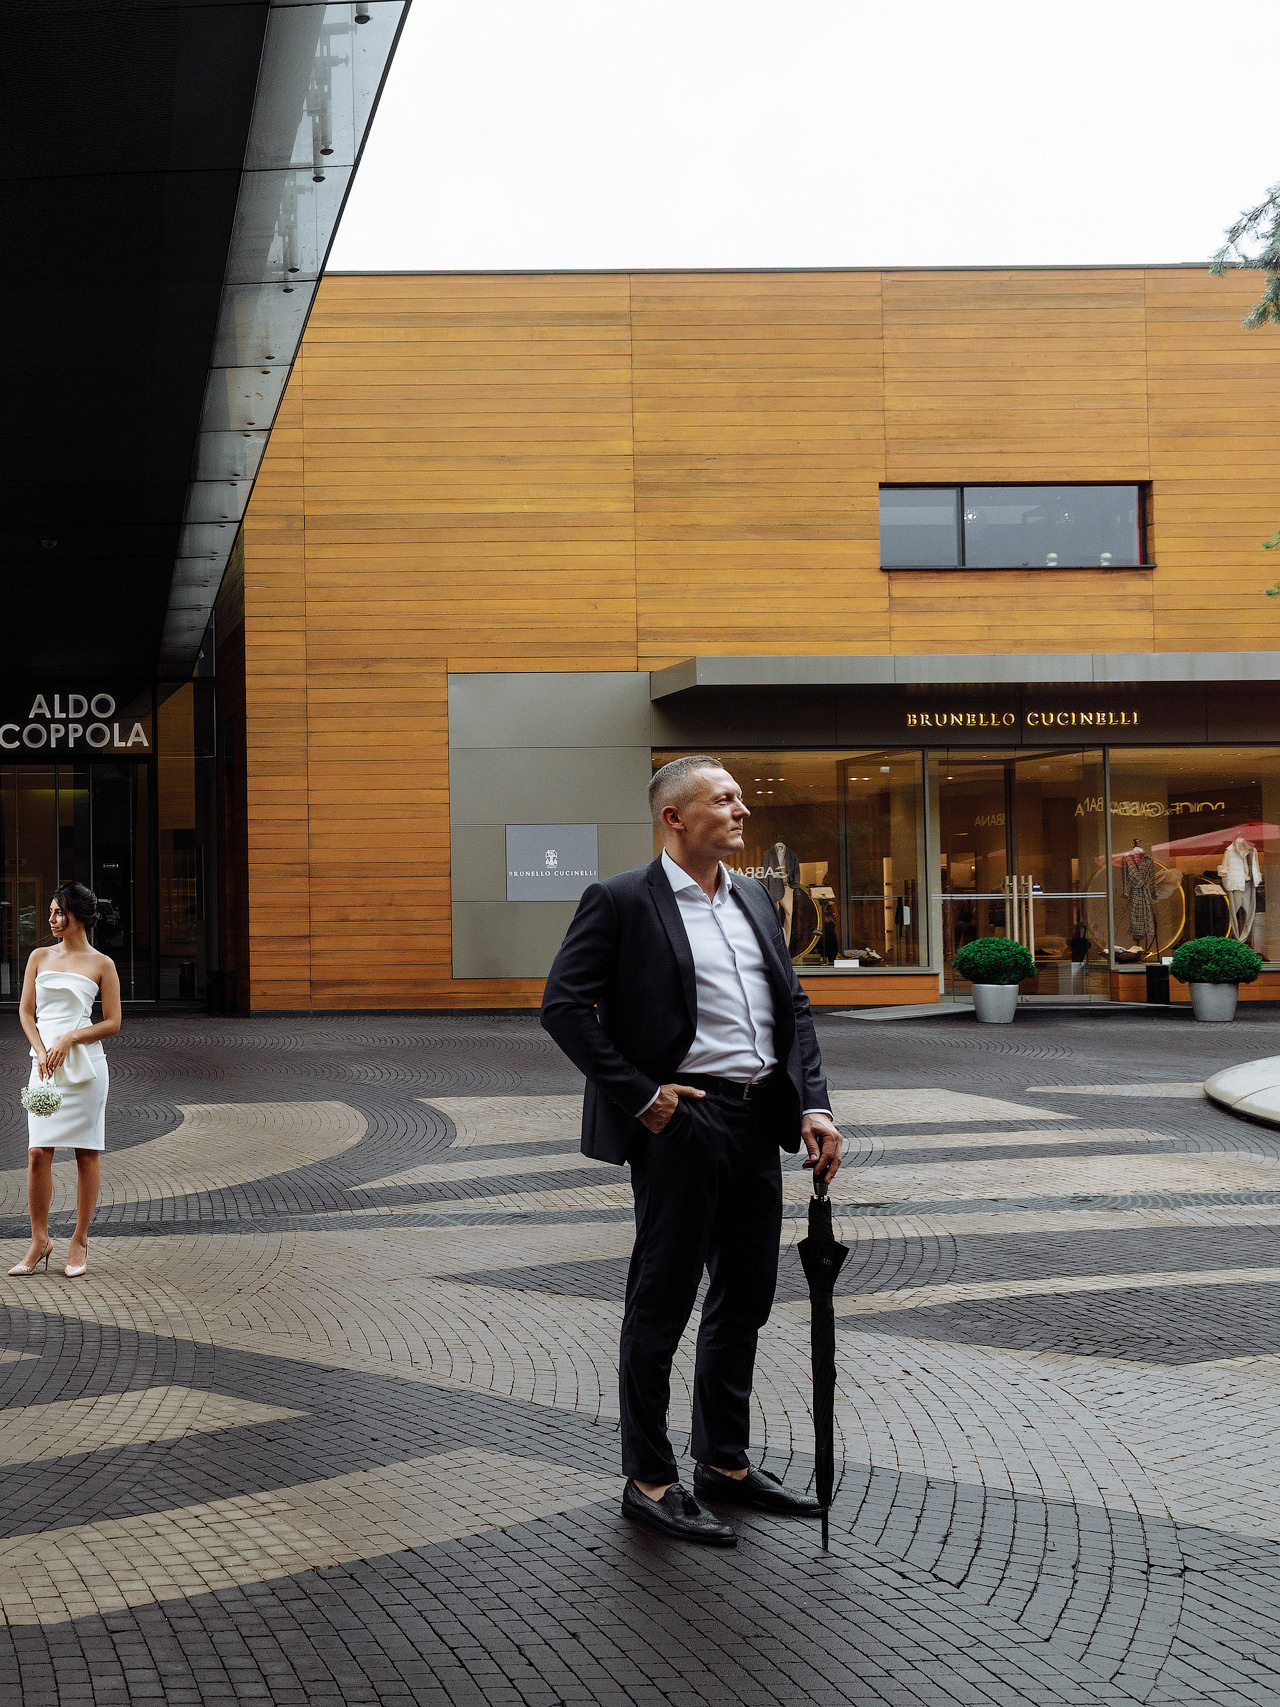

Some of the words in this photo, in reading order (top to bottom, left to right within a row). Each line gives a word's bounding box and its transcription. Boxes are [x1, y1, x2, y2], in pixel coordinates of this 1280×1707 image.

[28, 693, 116, 718] ALDO
[906, 711, 1015, 727] BRUNELLO
[1026, 710, 1140, 726] CUCINELLI
